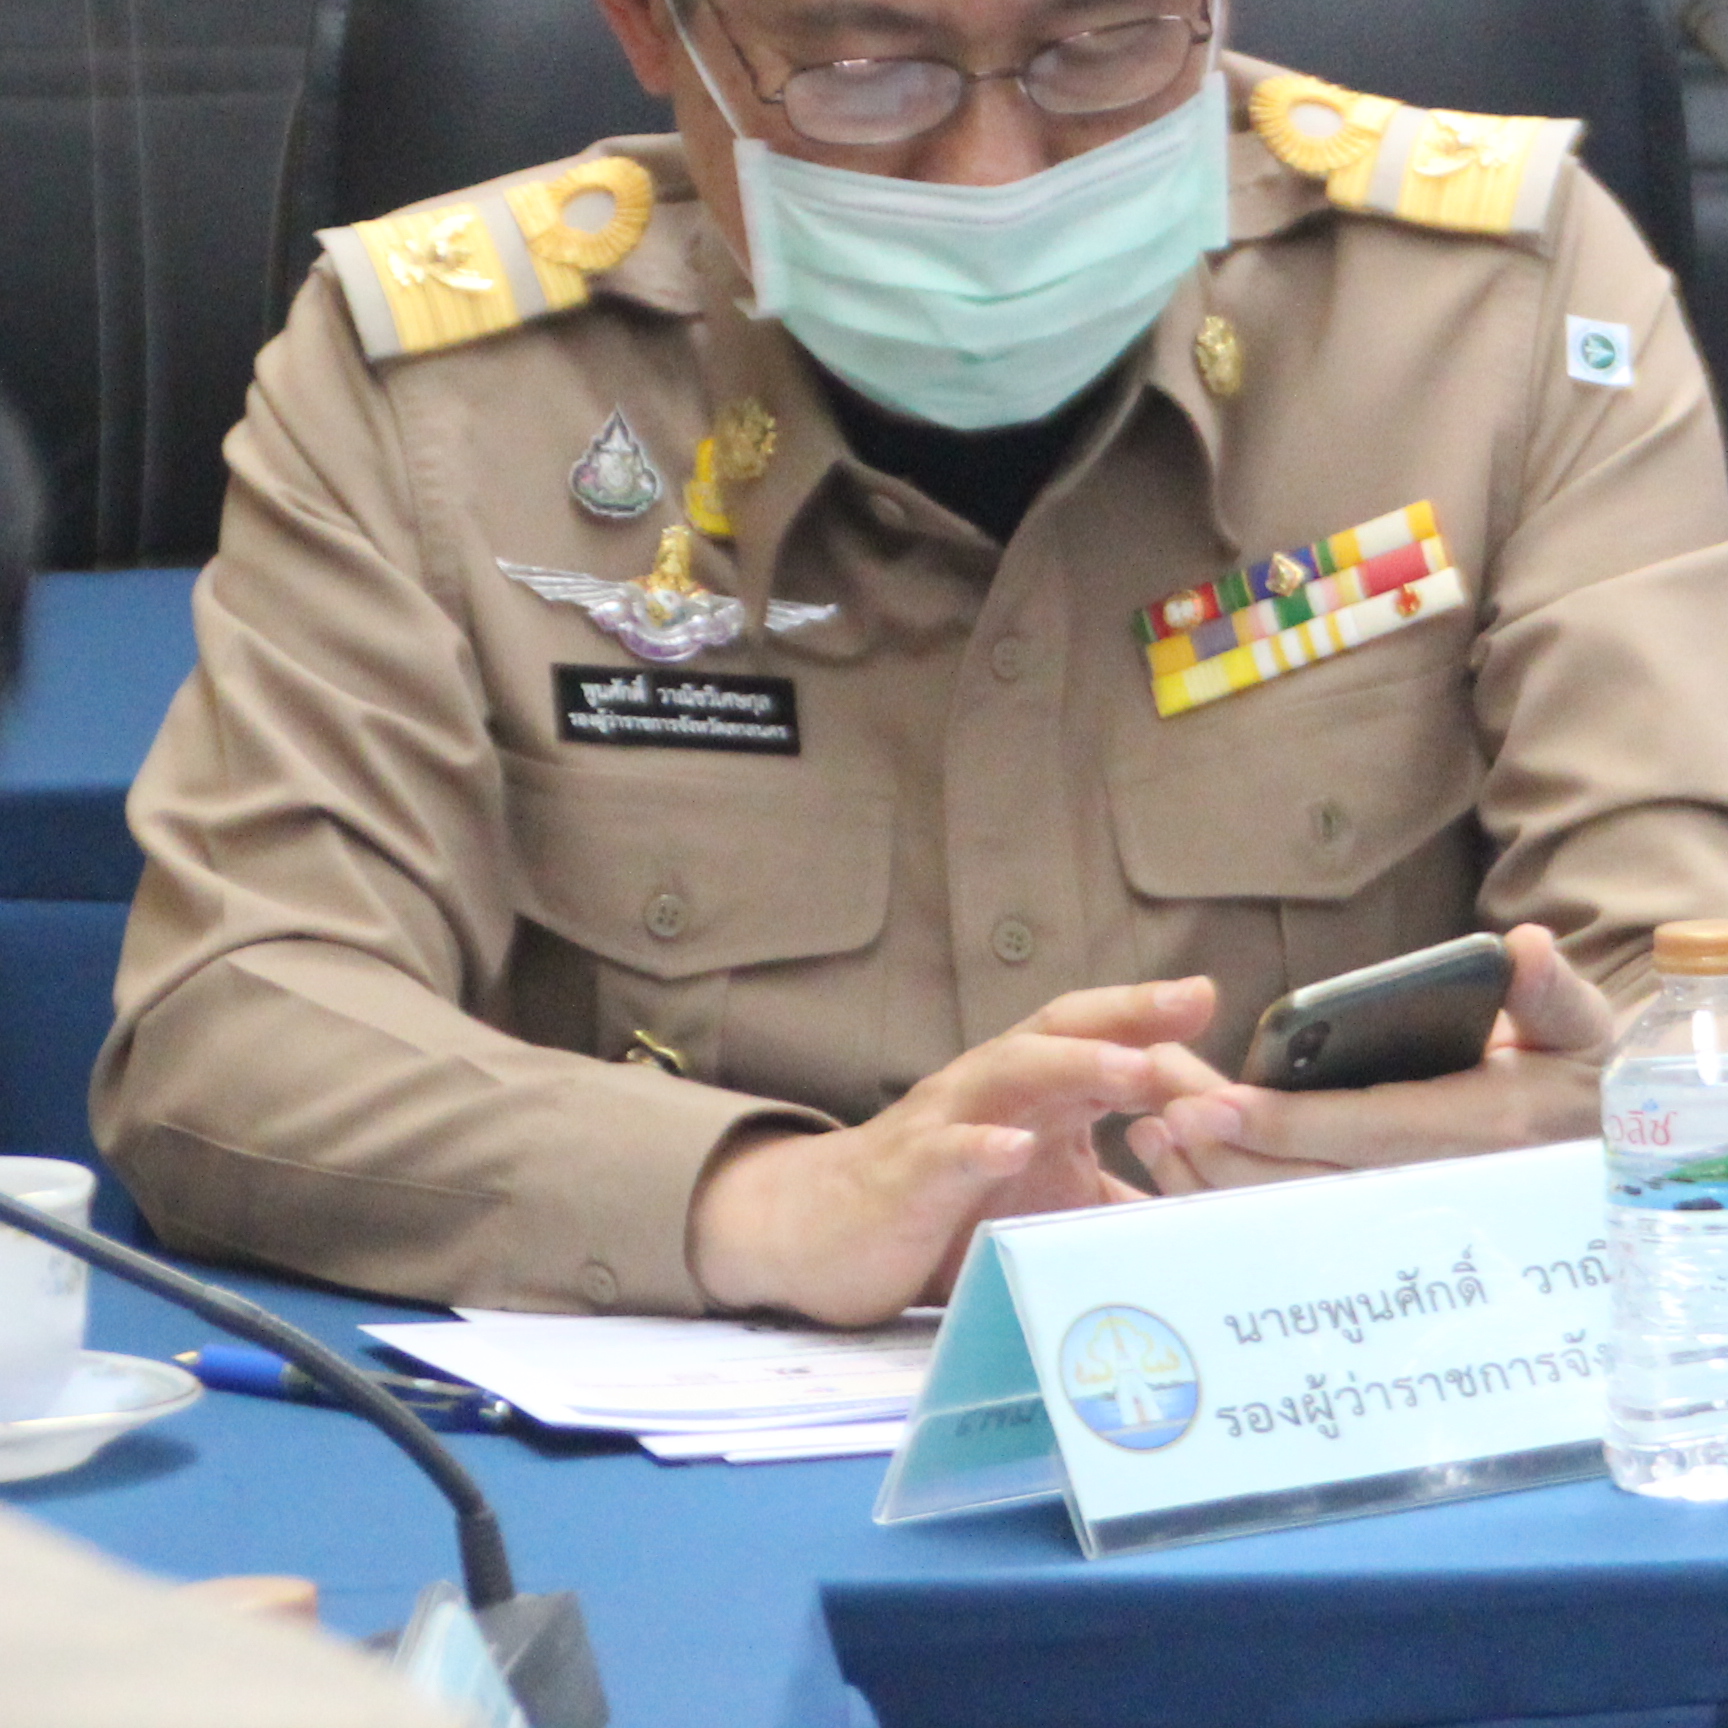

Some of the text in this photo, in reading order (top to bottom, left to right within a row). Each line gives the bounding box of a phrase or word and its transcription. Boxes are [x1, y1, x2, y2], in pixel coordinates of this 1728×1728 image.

[1223, 1244, 1488, 1344] นายพูนศักดิ์
